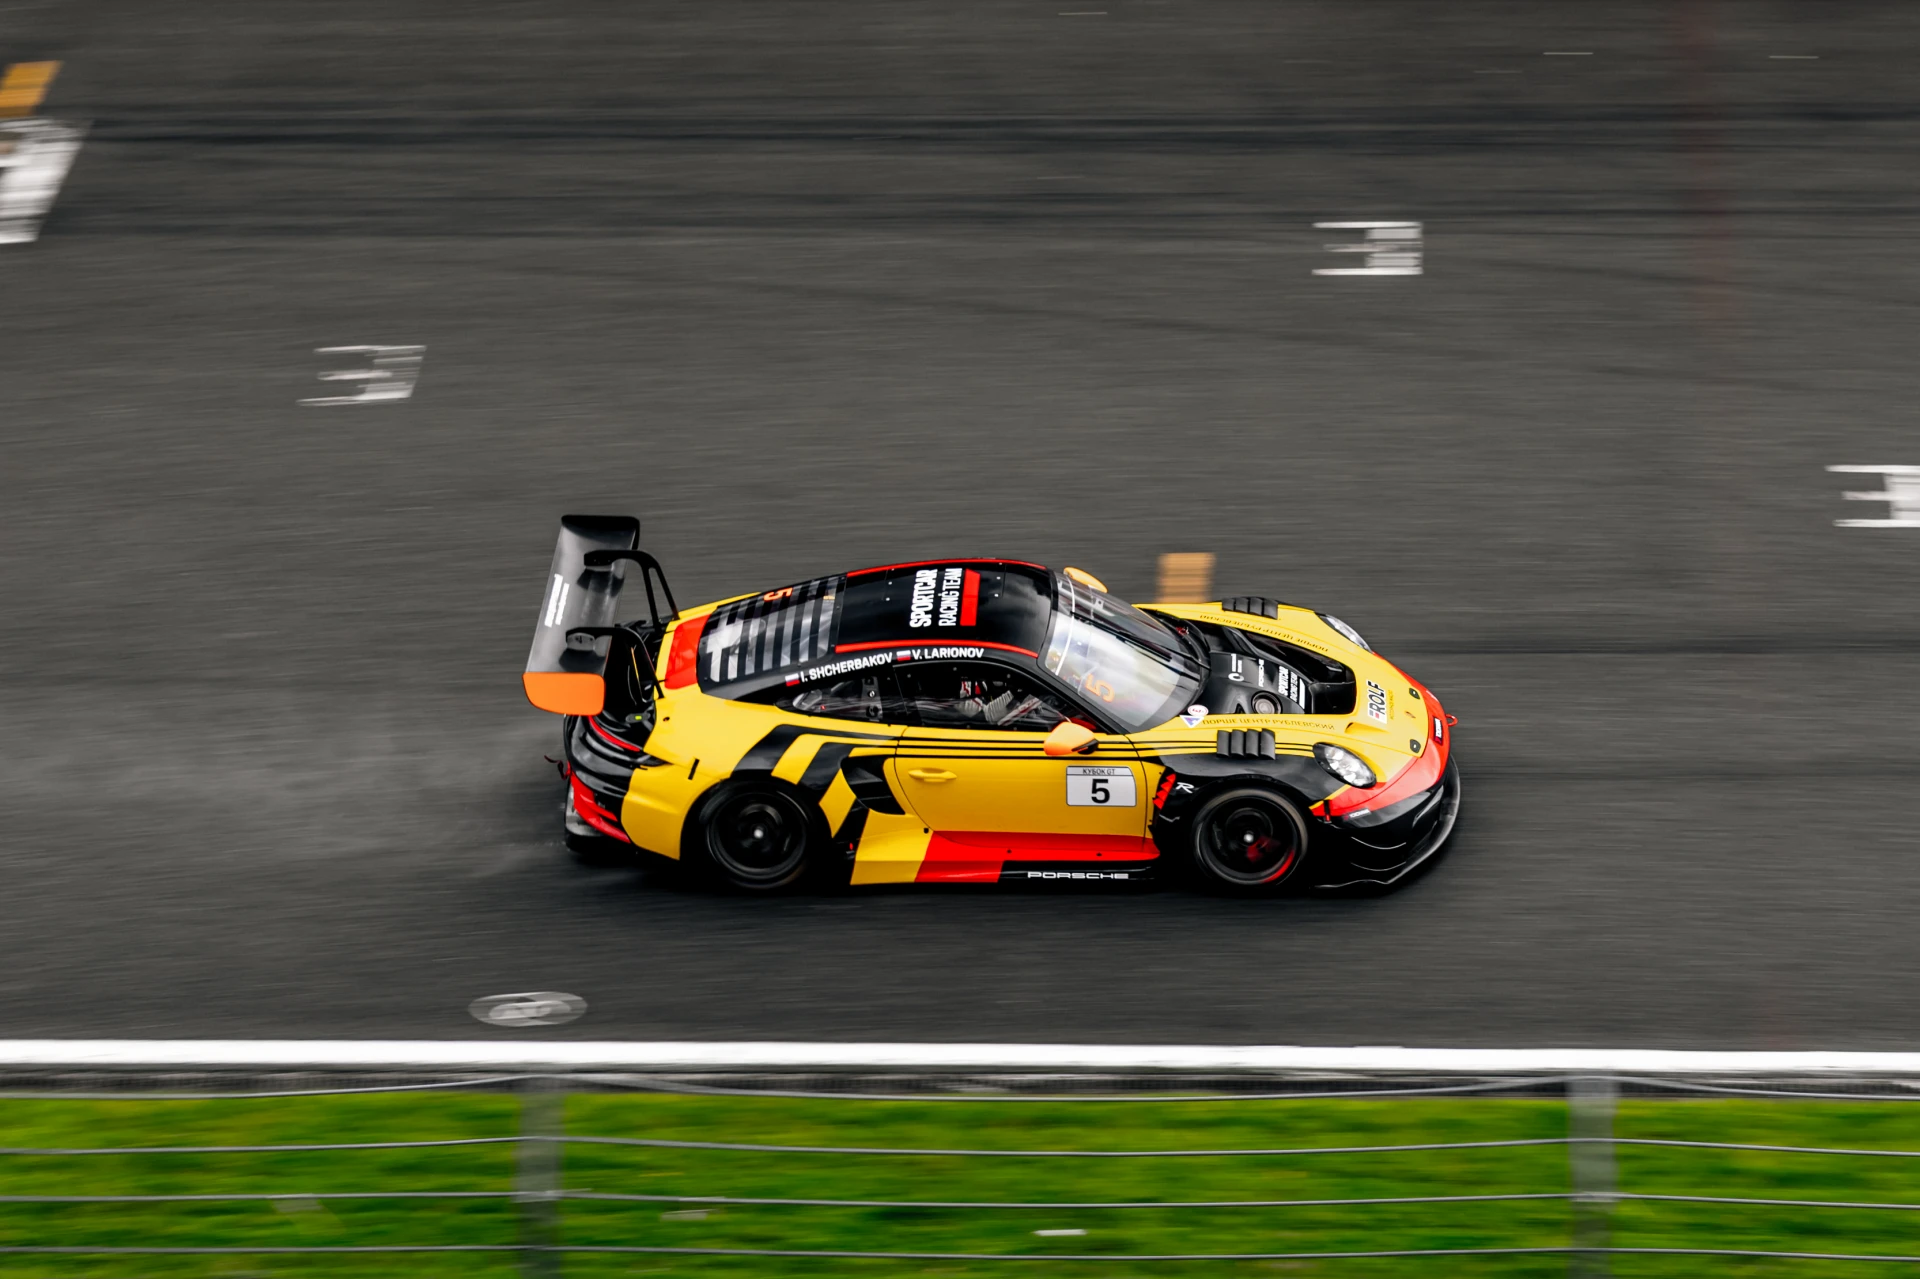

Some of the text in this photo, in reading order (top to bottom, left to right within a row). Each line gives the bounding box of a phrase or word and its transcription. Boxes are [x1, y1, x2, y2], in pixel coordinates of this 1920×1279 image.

[763, 587, 793, 602] 5
[910, 569, 937, 627] SPORTCAR
[938, 568, 962, 626] RACING TEAM
[912, 648, 985, 660] V. LARIONOV
[799, 652, 893, 683] I. SHCHERBAKOV
[1085, 673, 1115, 703] 5
[1367, 680, 1385, 716] ROLF
[1202, 718, 1237, 726] ПОРШЕ
[1239, 718, 1271, 726] ЦЕНТР
[1091, 778, 1110, 804] 5
[1175, 781, 1195, 794] R
[1027, 871, 1129, 880] PORSCHE
